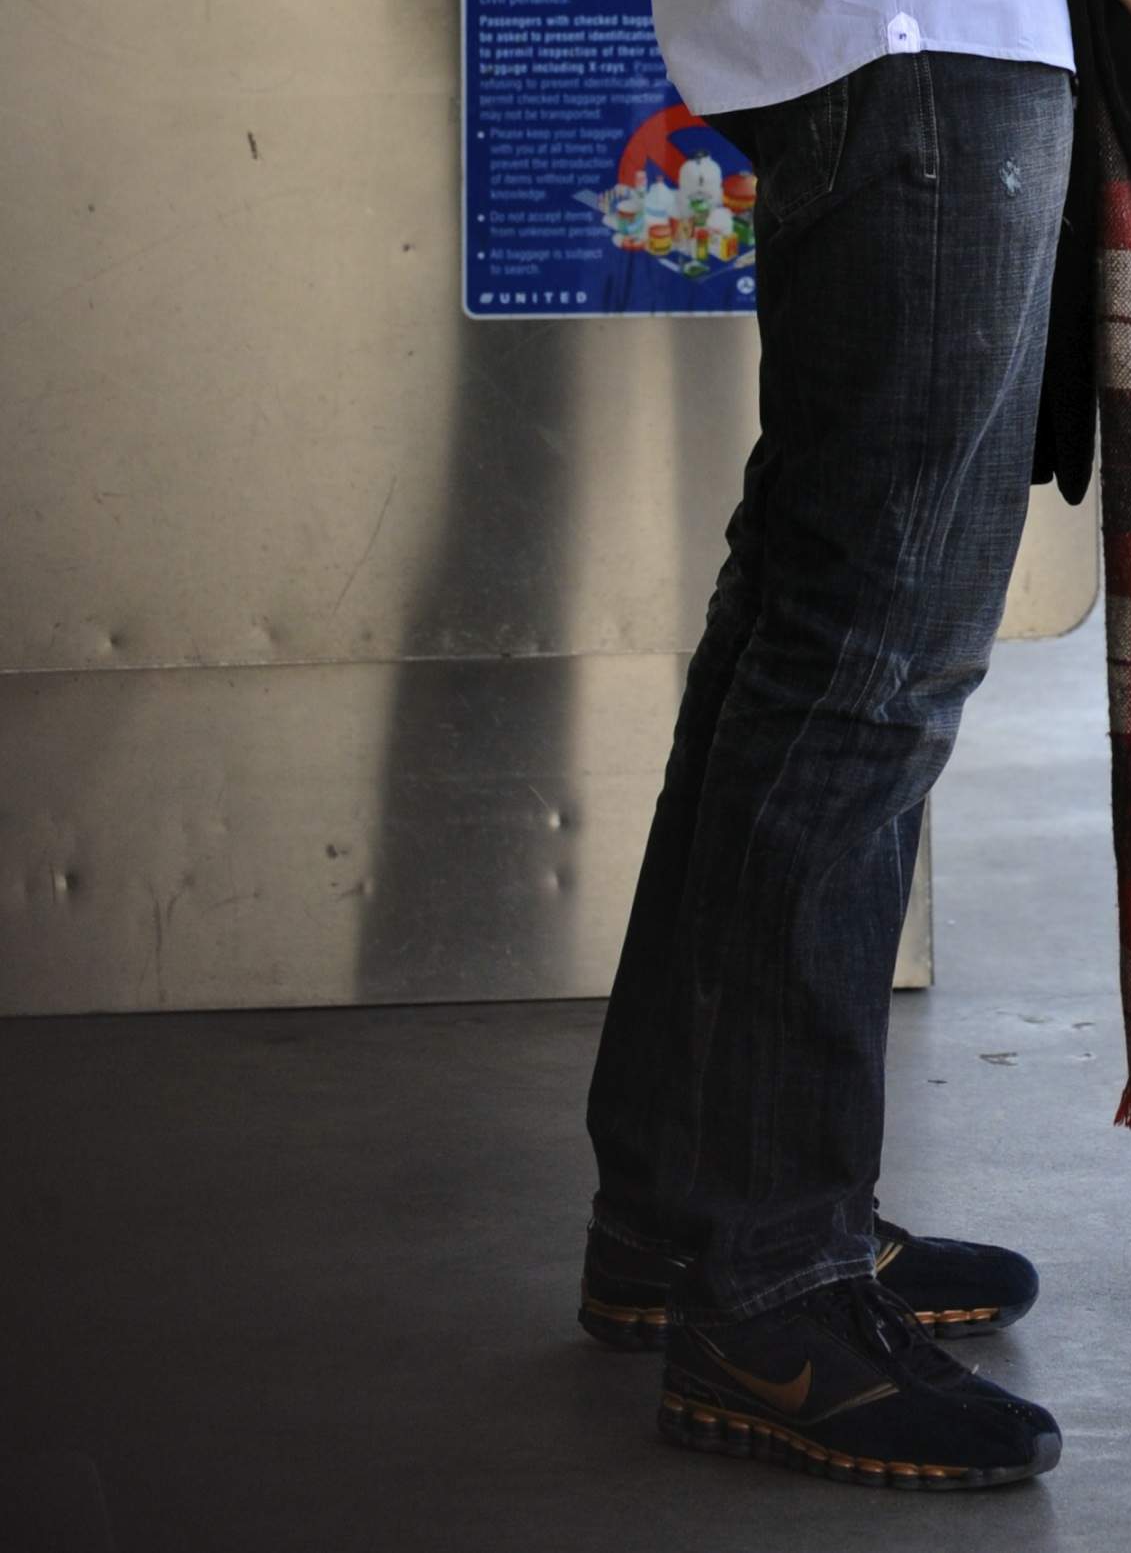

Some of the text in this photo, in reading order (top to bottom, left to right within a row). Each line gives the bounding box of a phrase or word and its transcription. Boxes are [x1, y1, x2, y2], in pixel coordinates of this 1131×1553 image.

[479, 15, 542, 28] Passengers
[546, 15, 569, 26] with
[573, 15, 618, 26] checked
[479, 31, 493, 42] be
[496, 31, 528, 42] asked
[531, 31, 541, 42] to
[544, 31, 585, 43] present
[479, 46, 492, 57] to
[495, 46, 533, 59] permit
[538, 46, 597, 59] inspection
[601, 46, 614, 57] of
[500, 292, 587, 304] UNITED
